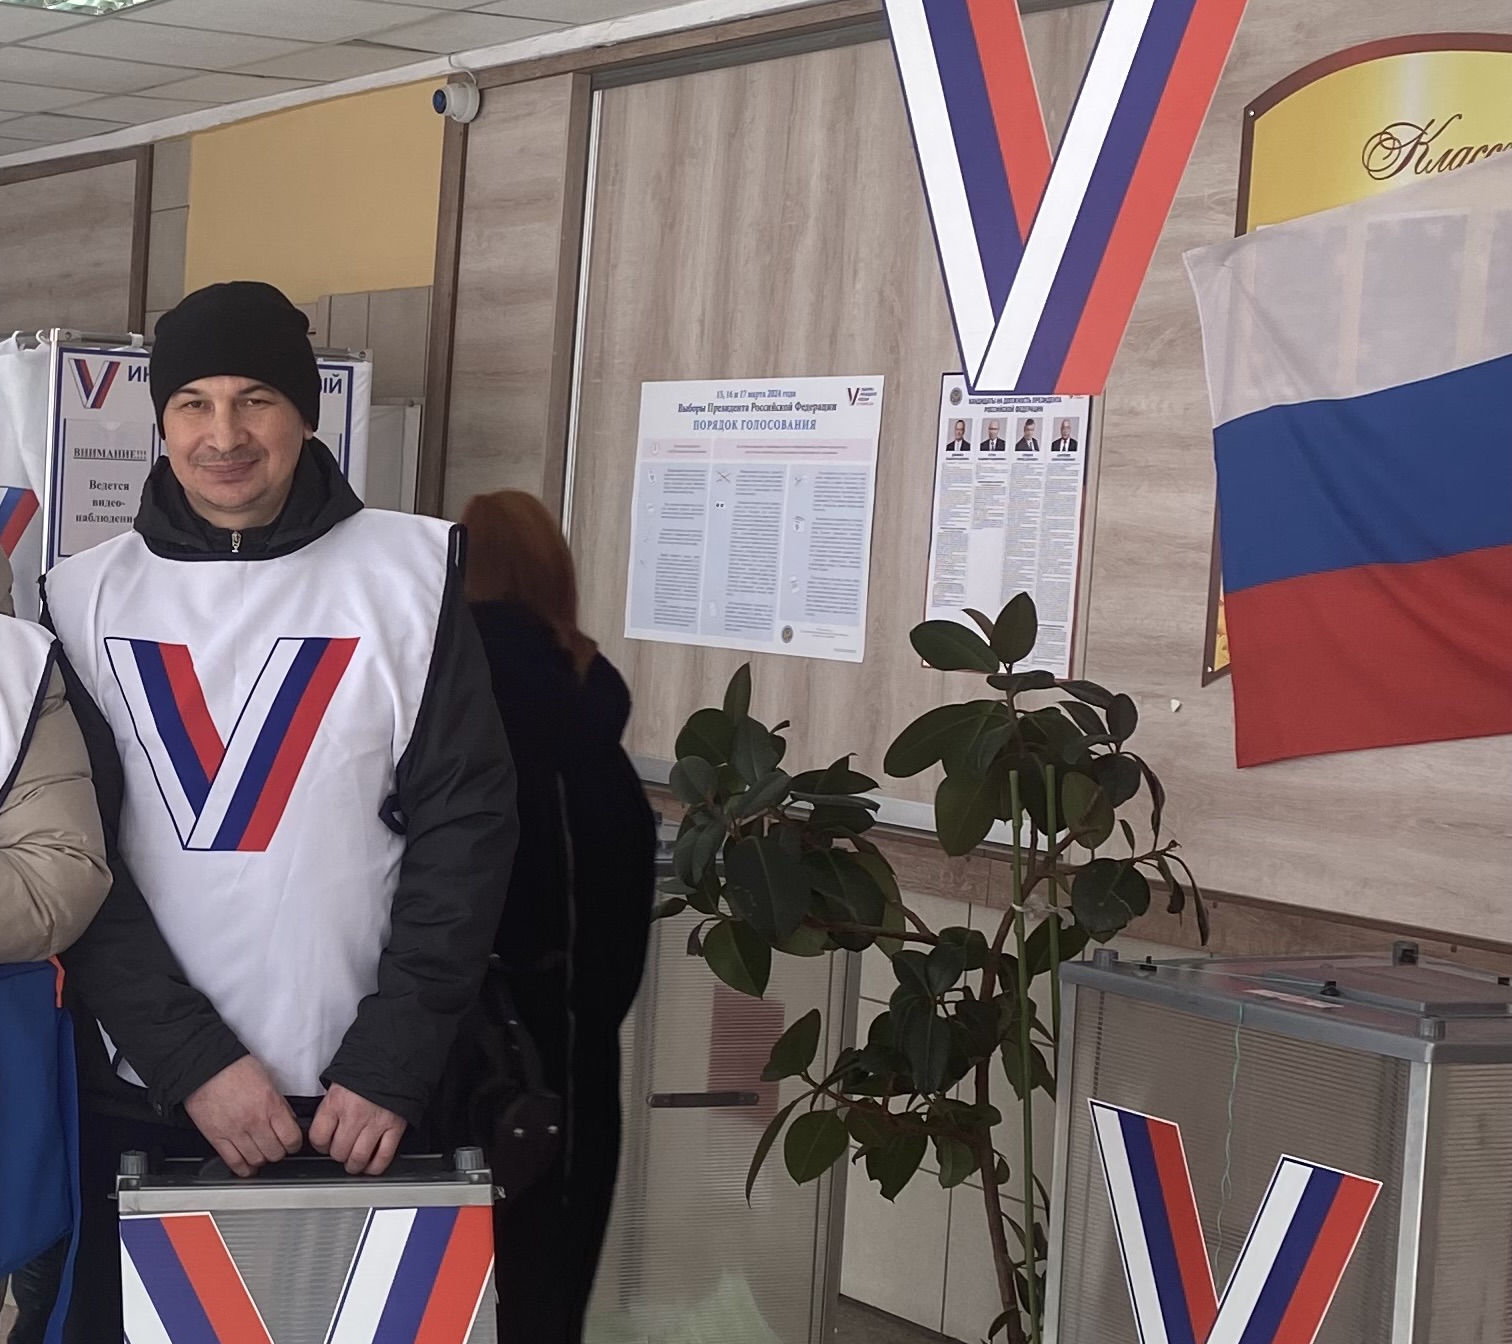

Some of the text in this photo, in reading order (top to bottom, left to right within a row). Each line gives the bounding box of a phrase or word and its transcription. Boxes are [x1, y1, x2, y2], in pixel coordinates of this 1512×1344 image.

[1362, 114, 1512, 181] Класс
[678, 401, 837, 415] Выборы Президента Российской Федерации
[693, 418, 817, 431] ПОРЯДОК ГОЛОСОВАНИЯ
[89, 479, 129, 491] Ведется
[92, 499, 126, 507] видео-
[75, 512, 133, 523] наблюдени
